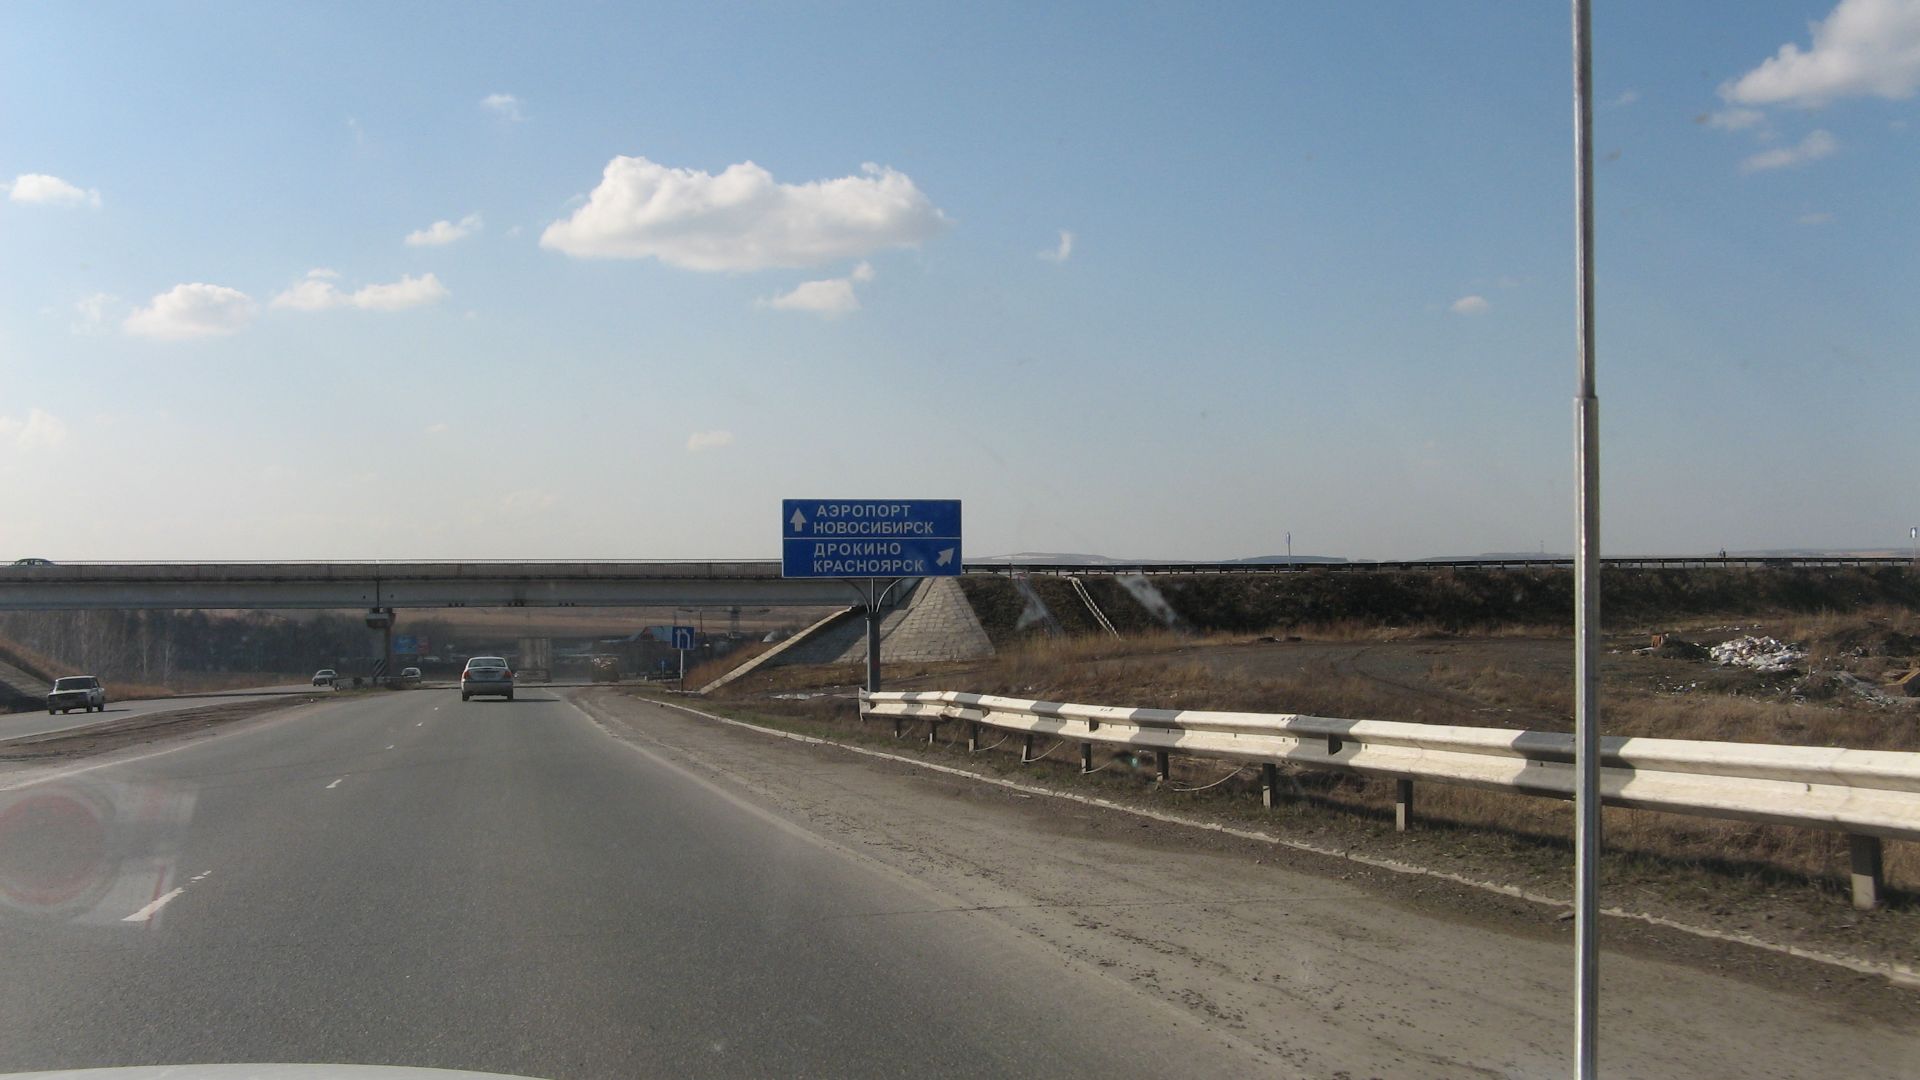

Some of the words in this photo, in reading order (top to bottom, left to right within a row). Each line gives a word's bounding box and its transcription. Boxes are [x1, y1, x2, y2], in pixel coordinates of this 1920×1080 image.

[816, 505, 911, 517] АЭРОПОРТ
[813, 522, 933, 534] НОВОСИБИРСК
[813, 543, 901, 557] ДРОКИНО
[813, 560, 924, 573] КРАСНОЯРСК
